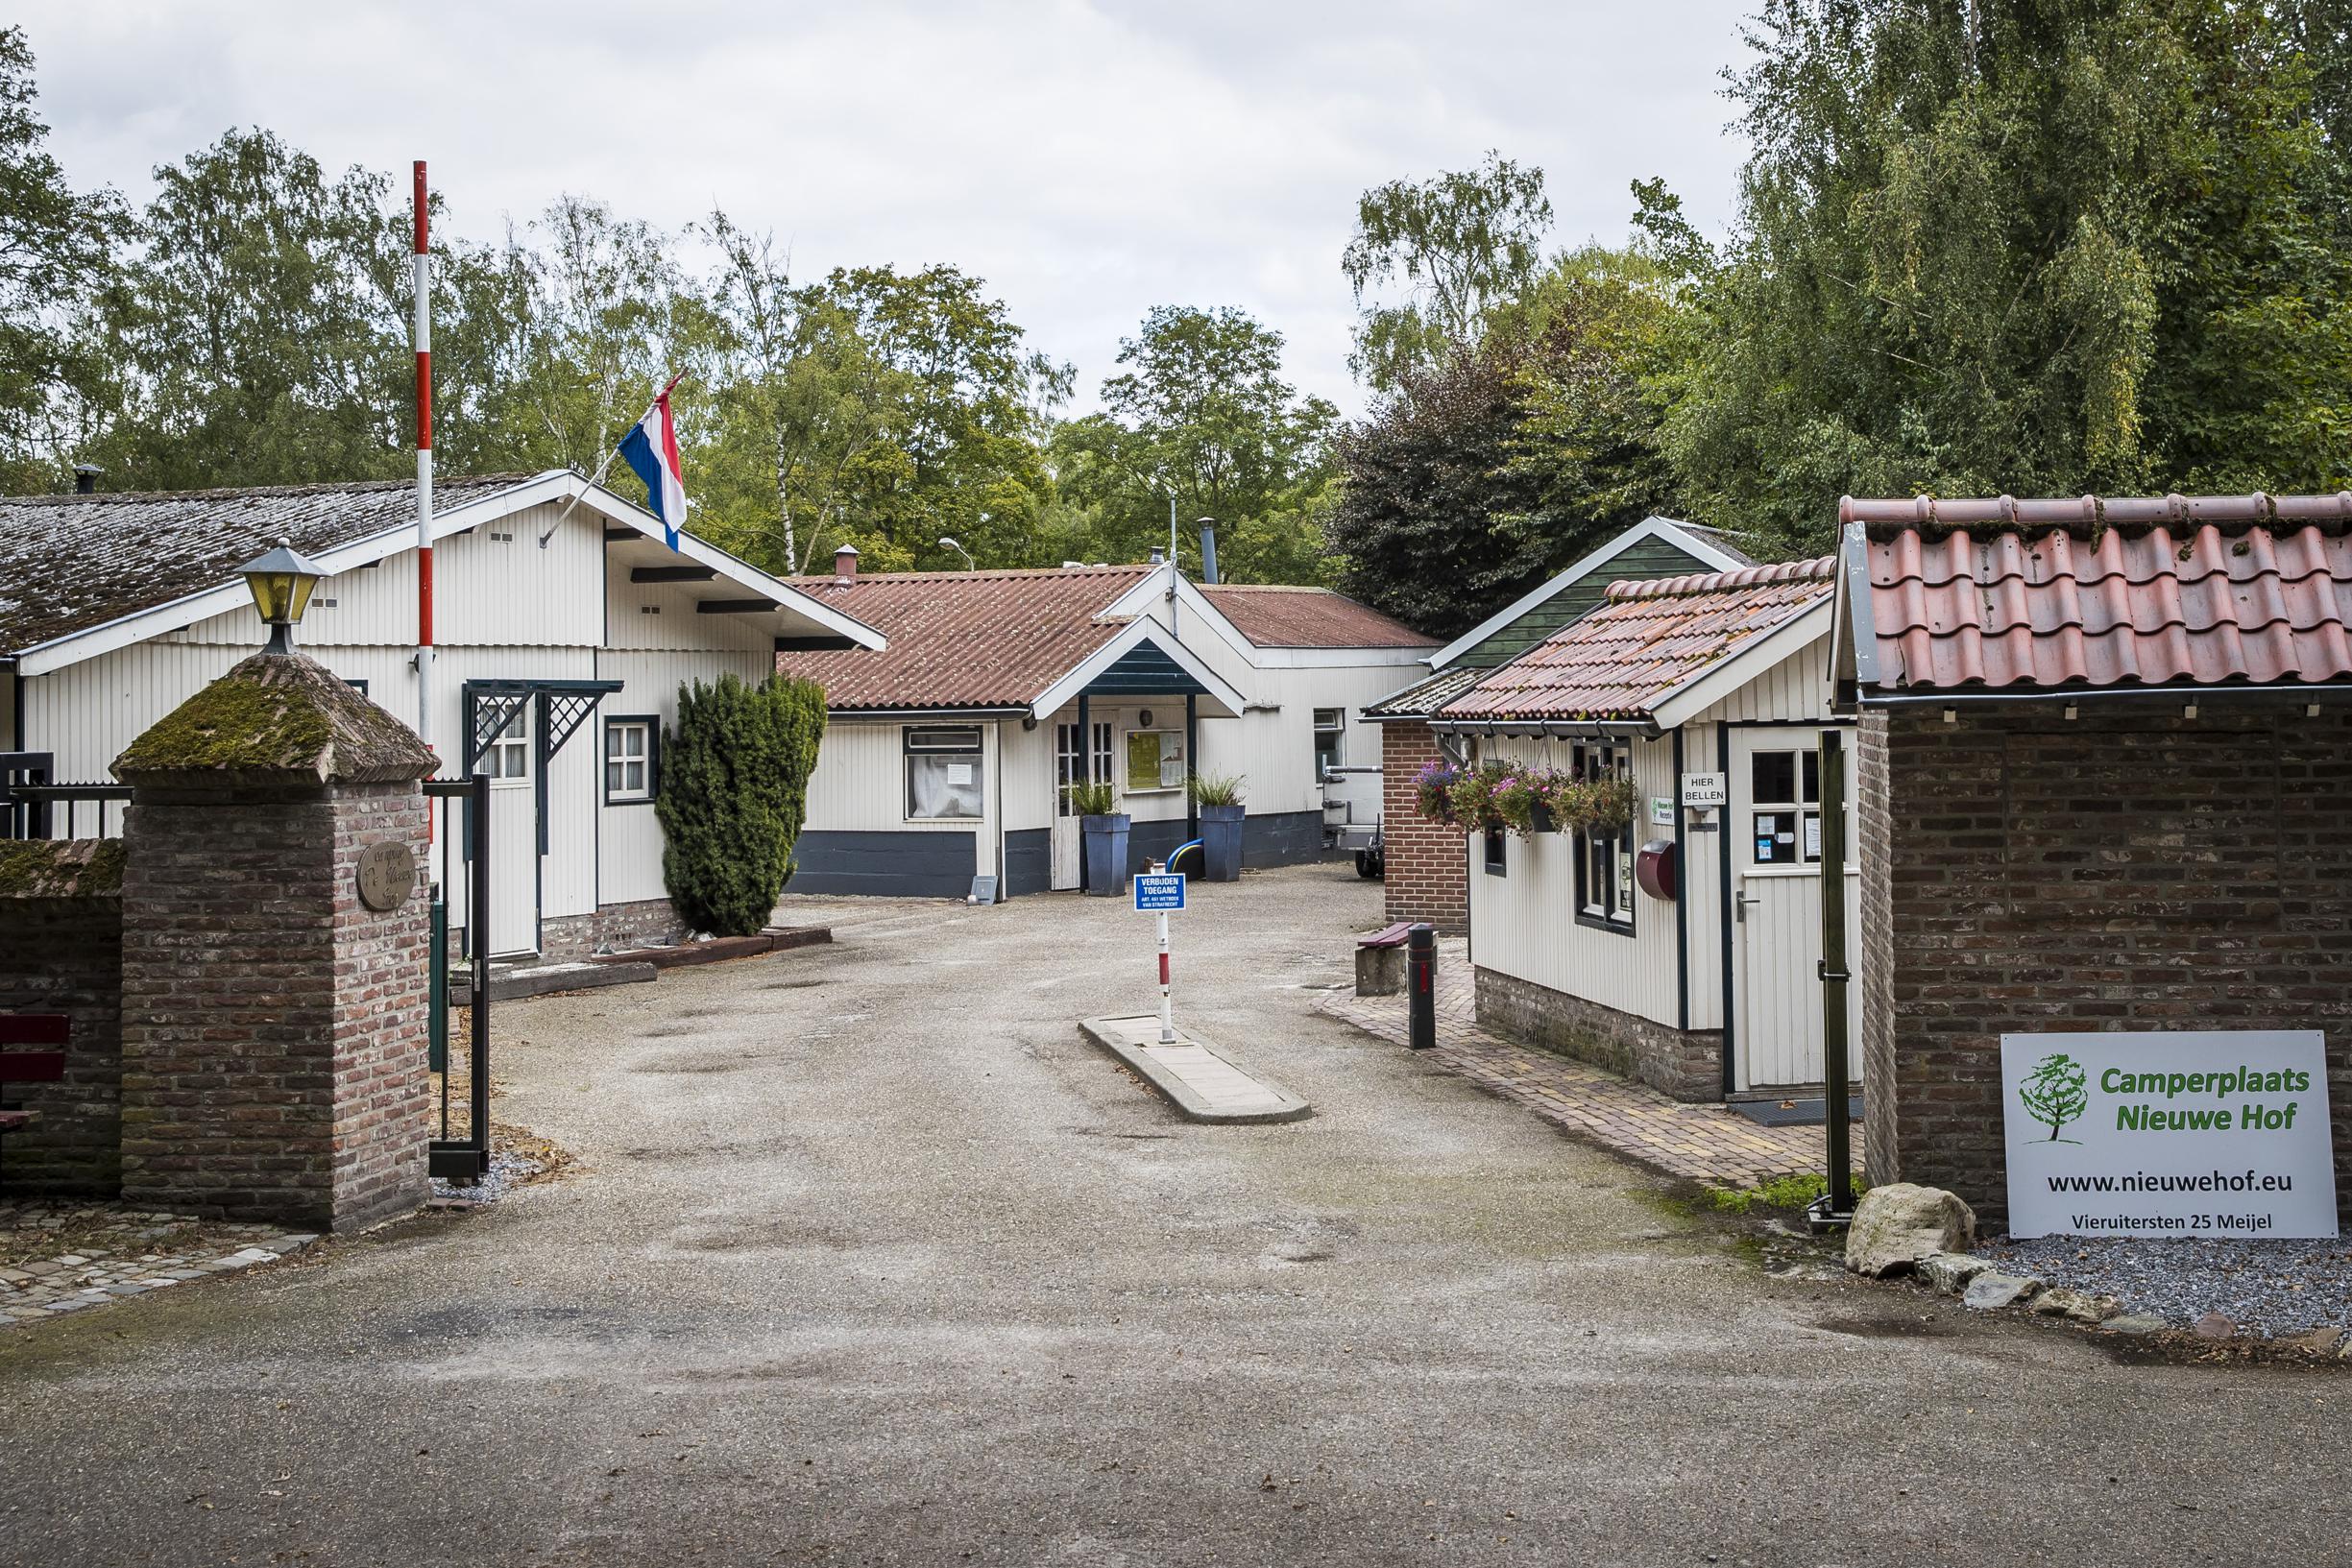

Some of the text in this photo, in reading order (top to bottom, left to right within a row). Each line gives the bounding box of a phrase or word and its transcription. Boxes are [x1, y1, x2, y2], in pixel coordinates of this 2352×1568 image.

[1690, 778, 1714, 787] HIER
[1685, 790, 1724, 801] BELLEN
[1141, 877, 1179, 886] VERBODEN
[1143, 886, 1177, 895] TOEGANG
[2100, 1065, 2311, 1098] Camperplaats
[2116, 1102, 2298, 1131] Nieuwe Hof
[2048, 1170, 2292, 1193] www.nieuwehof.eu
[2072, 1213, 2272, 1232] Vieruitersten 25 Meijel
